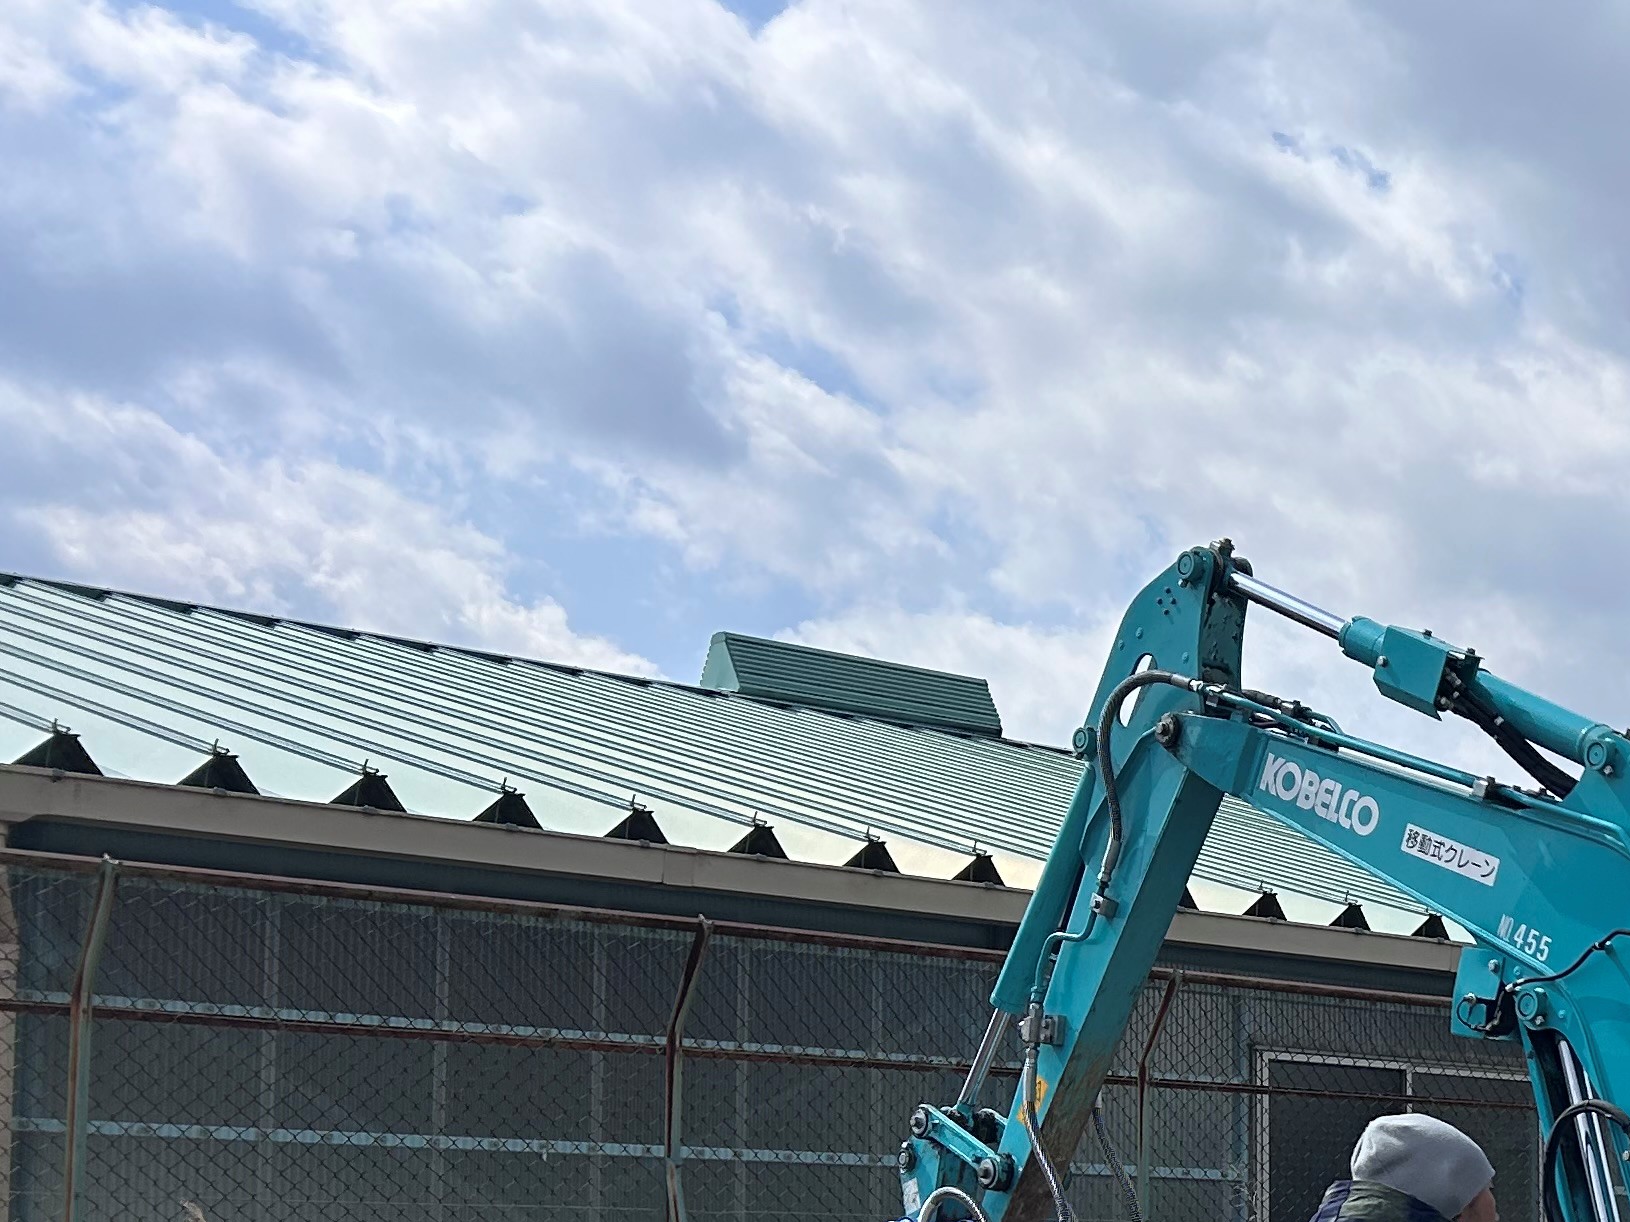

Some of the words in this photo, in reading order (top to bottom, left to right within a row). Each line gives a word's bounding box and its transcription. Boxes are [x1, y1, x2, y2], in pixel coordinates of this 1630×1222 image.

[1260, 753, 1379, 836] KOBELCO
[1405, 828, 1496, 877] 移動式クレーン
